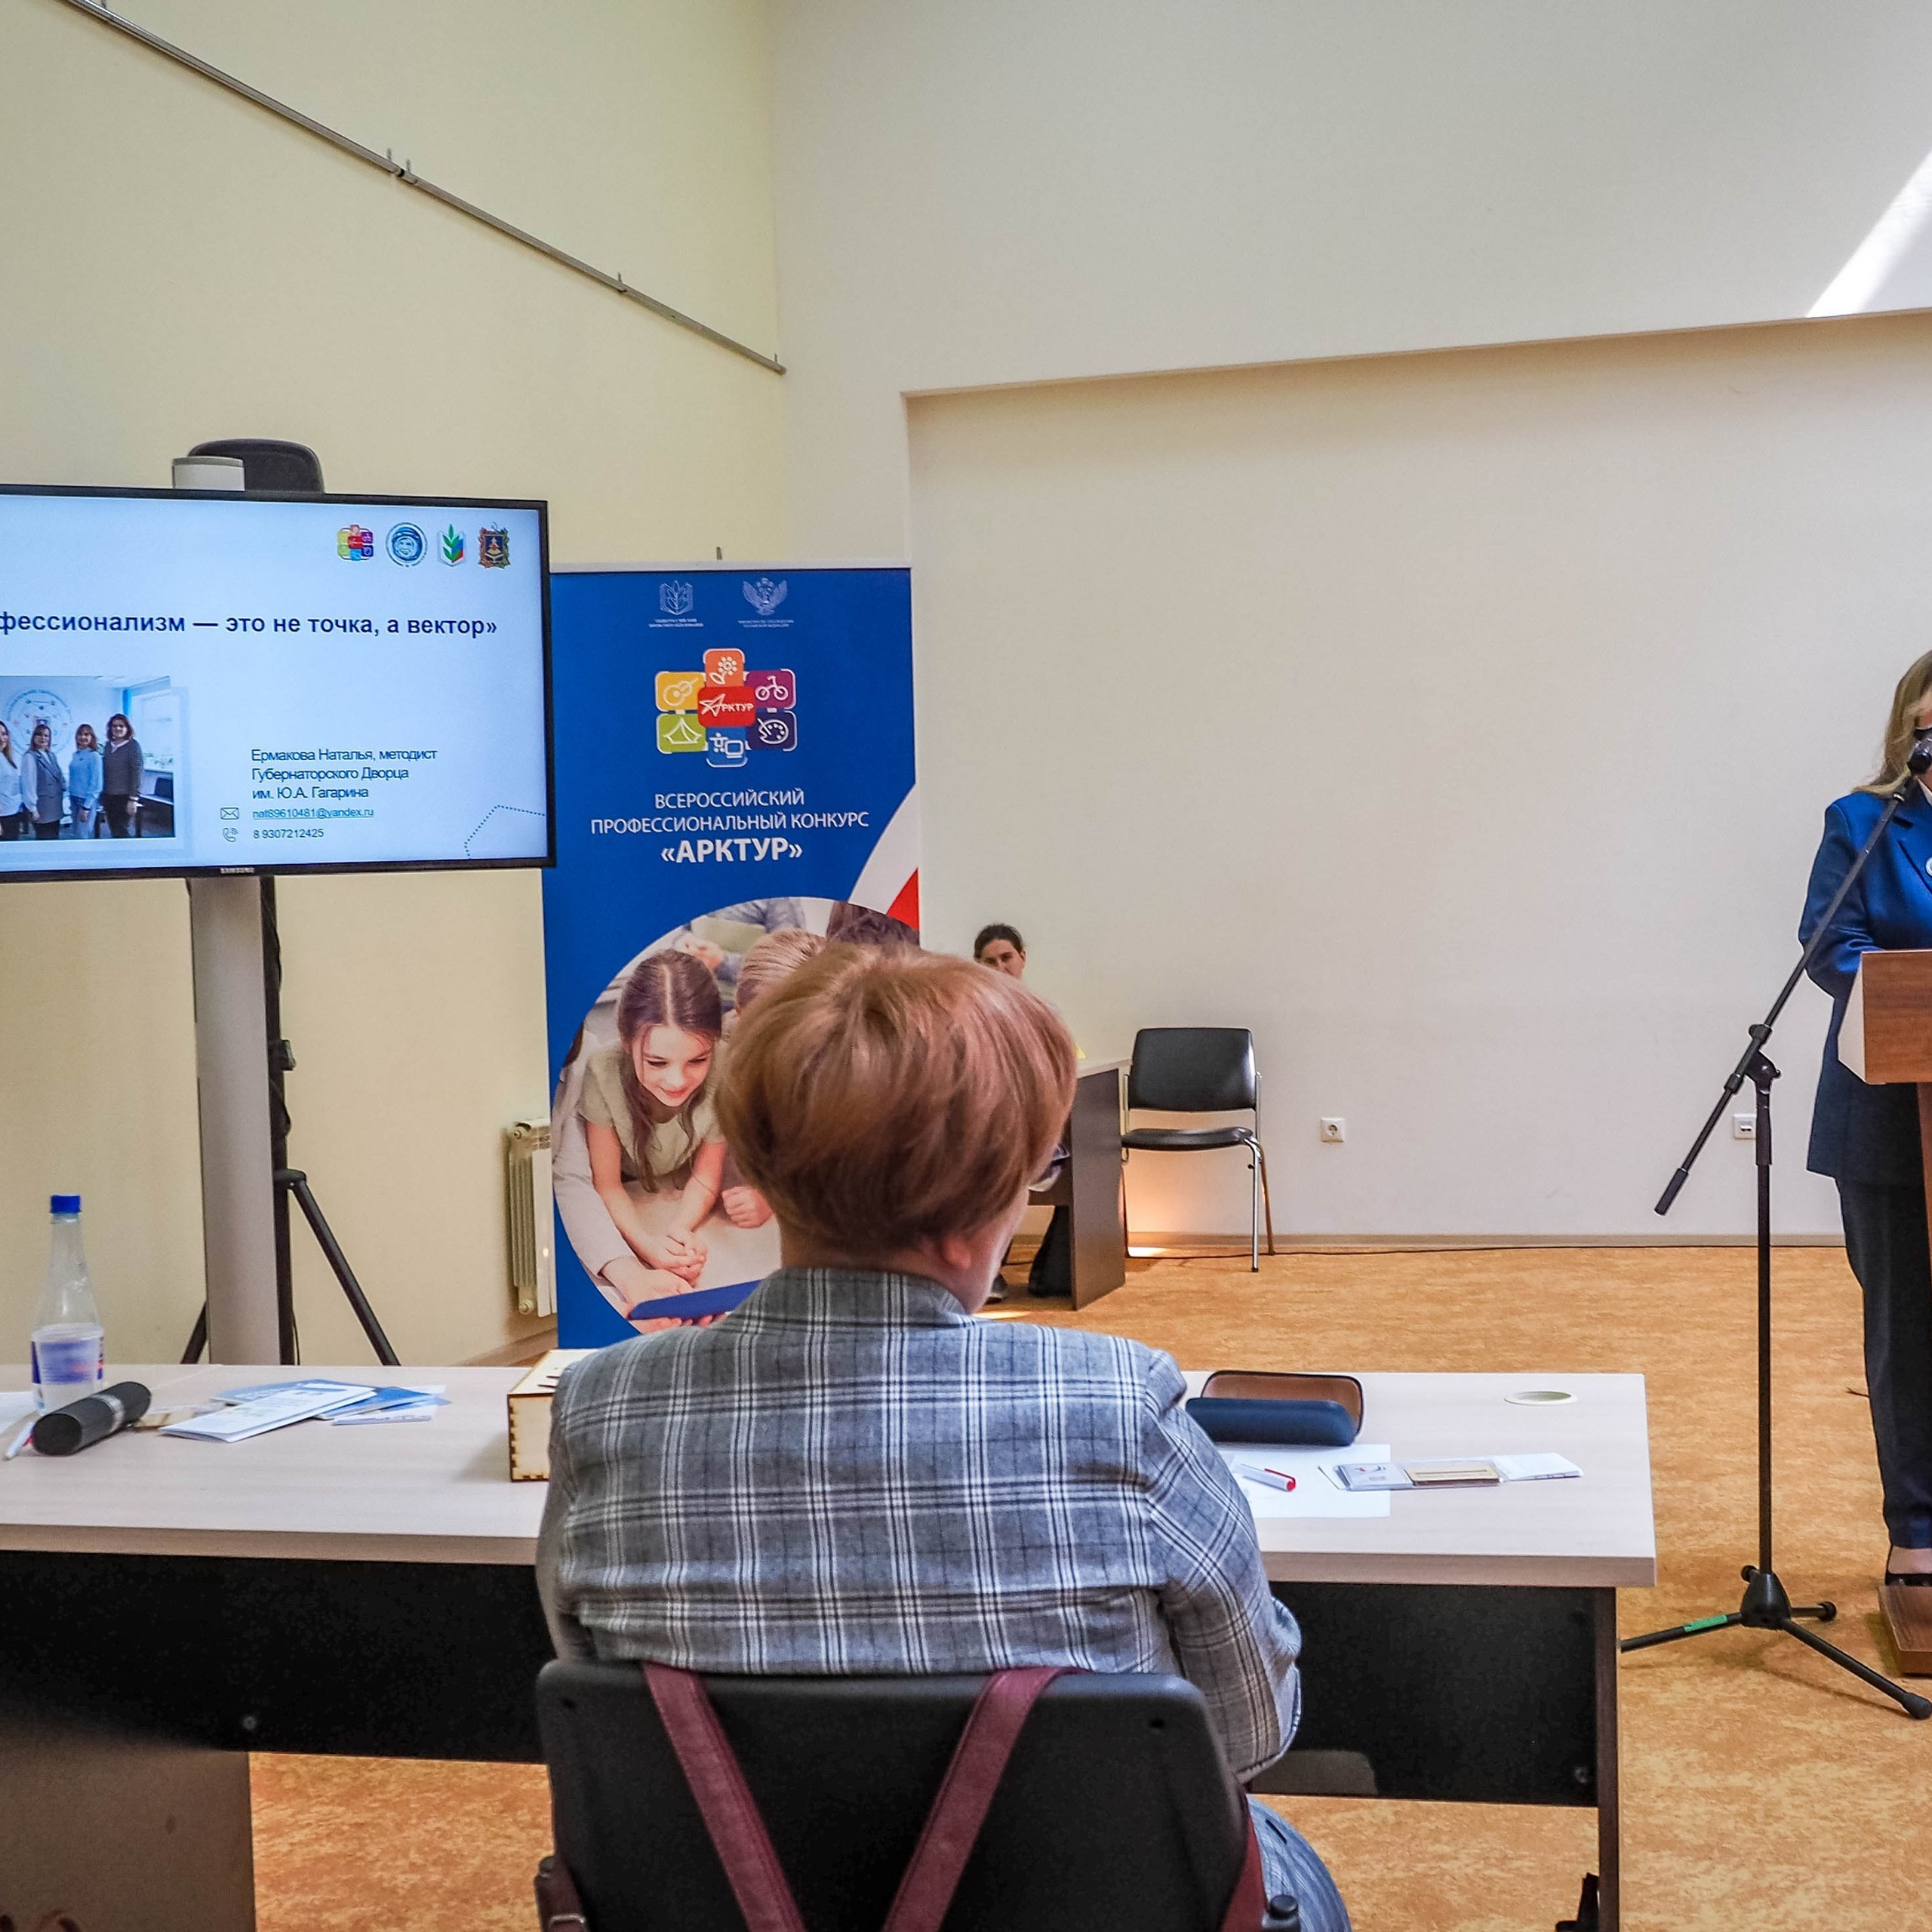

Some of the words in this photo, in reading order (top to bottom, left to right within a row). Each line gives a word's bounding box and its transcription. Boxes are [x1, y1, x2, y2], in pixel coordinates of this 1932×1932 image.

[0, 611, 186, 635] фессионализм
[226, 617, 266, 632] это
[273, 617, 301, 632] не
[307, 617, 379, 636] точка,
[386, 618, 399, 634] а
[407, 619, 497, 639] вектор»
[251, 749, 315, 764] Ермакова
[318, 748, 377, 761] Наталья,
[378, 749, 438, 762] методист
[251, 768, 359, 783] Губернаторского
[361, 766, 410, 782] Дворца
[251, 788, 274, 800] им.
[311, 786, 369, 801] Гагарина
[654, 788, 805, 810] ВСЕРОССИЙСКИЙ
[590, 811, 787, 835] ПРОФЕССИОНАЛЬНЫЙ
[790, 811, 870, 830] КОНКУРС
[253, 829, 260, 839] 8
[262, 828, 325, 839] 9307212425
[660, 837, 804, 864] «АРКТУР»
